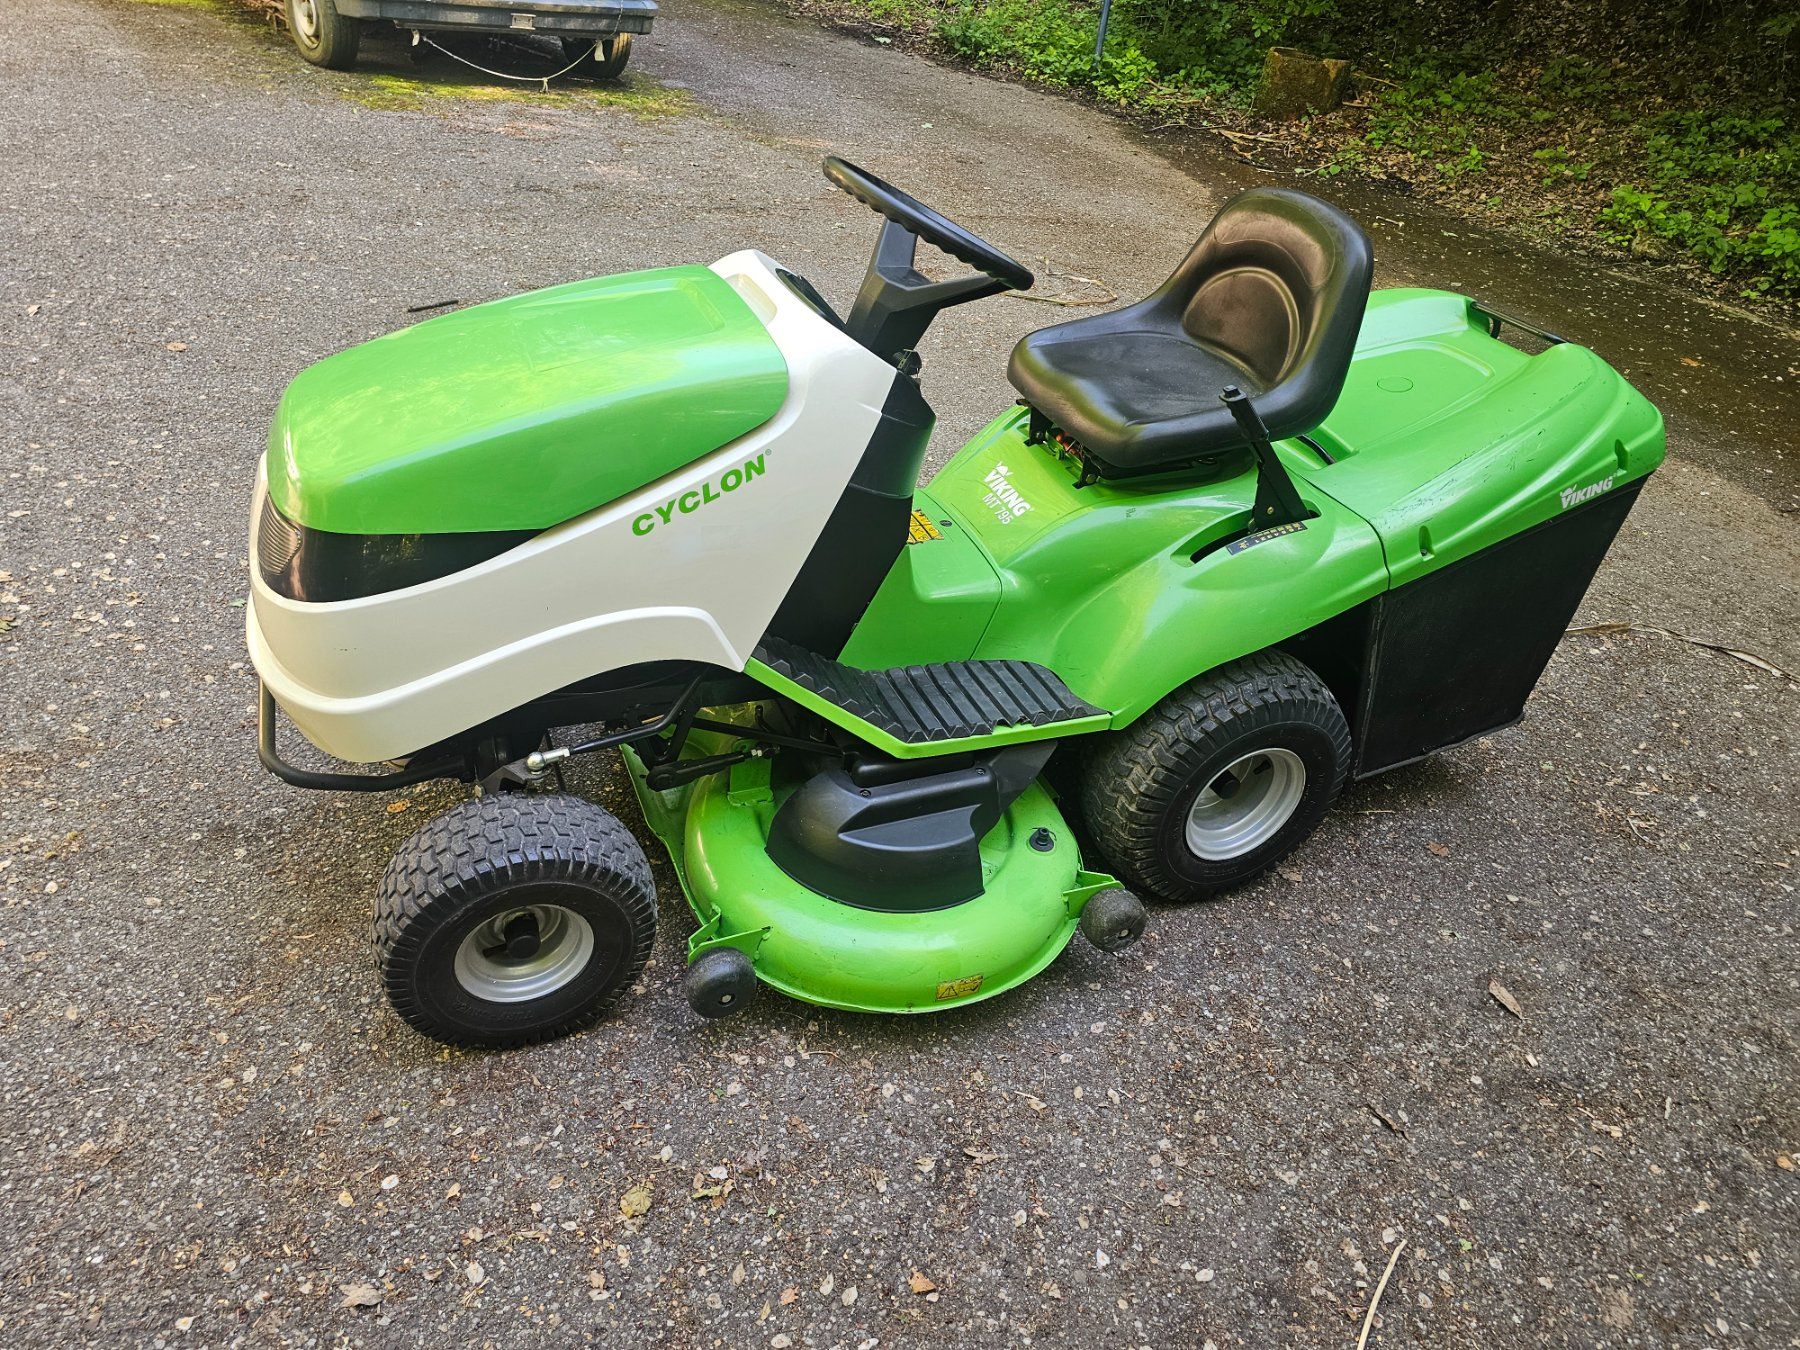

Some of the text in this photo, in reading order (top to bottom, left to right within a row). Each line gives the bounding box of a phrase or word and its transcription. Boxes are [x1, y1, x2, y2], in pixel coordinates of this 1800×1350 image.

[632, 453, 766, 536] CYCLON
[982, 493, 1014, 525] MT 795
[984, 468, 1031, 517] VIKING
[1561, 476, 1613, 509] VIKING
